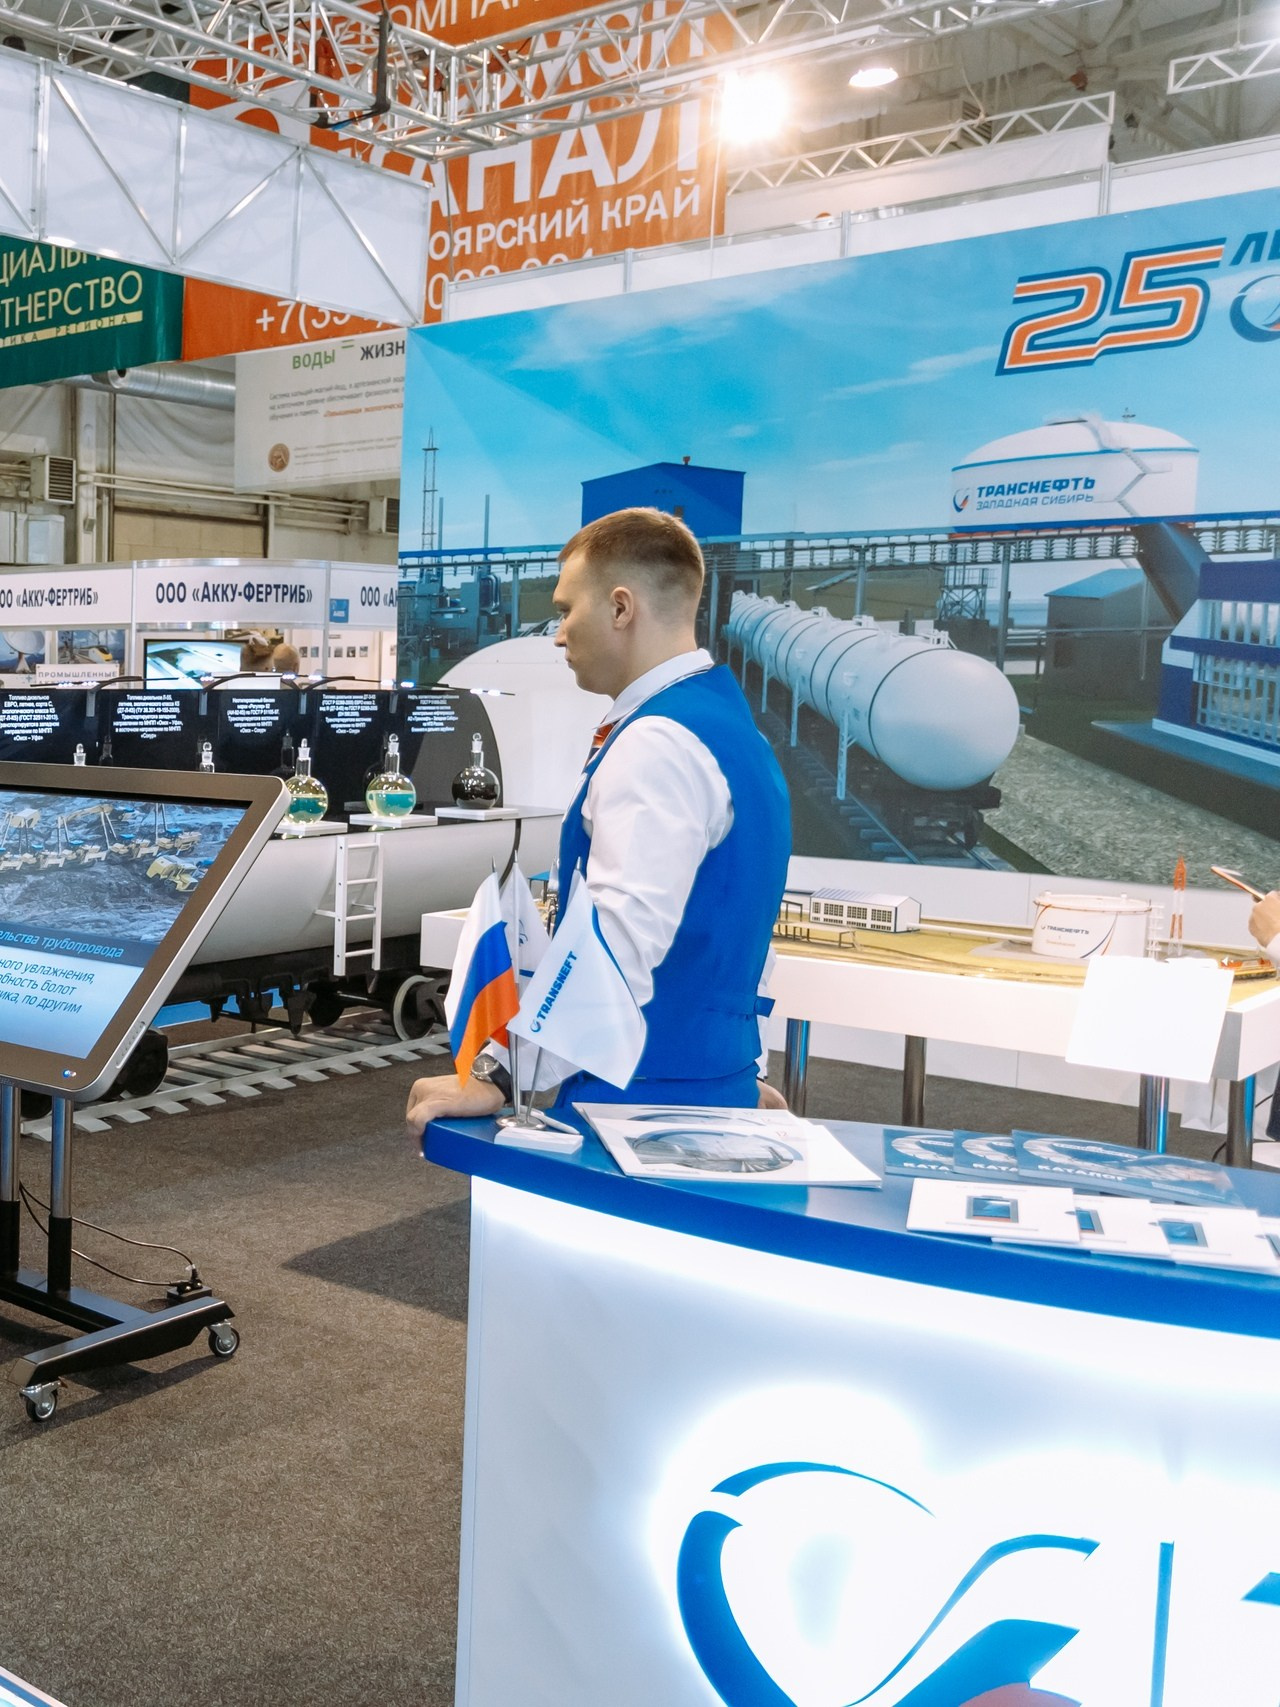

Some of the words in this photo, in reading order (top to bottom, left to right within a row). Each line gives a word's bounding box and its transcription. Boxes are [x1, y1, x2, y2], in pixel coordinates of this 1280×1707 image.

[602, 178, 700, 231] КРАЙ
[995, 237, 1226, 376] 25
[55, 315, 128, 336] РЕГИОНА
[977, 476, 1096, 498] ТРАНСНЕФТЬ
[976, 497, 1038, 511] ЗАПАДНАЯ
[1041, 494, 1094, 506] СИБИРЬ
[16, 587, 99, 608] «АККУ-ФЕРТРИБ»
[156, 581, 187, 604] ООО
[192, 581, 313, 604] «АККУ-ФЕРТРИБ»
[360, 586, 380, 607] ООО
[42, 937, 124, 958] трубопровода
[21, 963, 95, 984] увлажнения,
[40, 980, 77, 996] болот
[537, 950, 578, 1021] TRANSNEFT
[21, 993, 36, 1006] по
[37, 997, 83, 1015] другим
[1038, 1164, 1128, 1181] КАТАЛОГ
